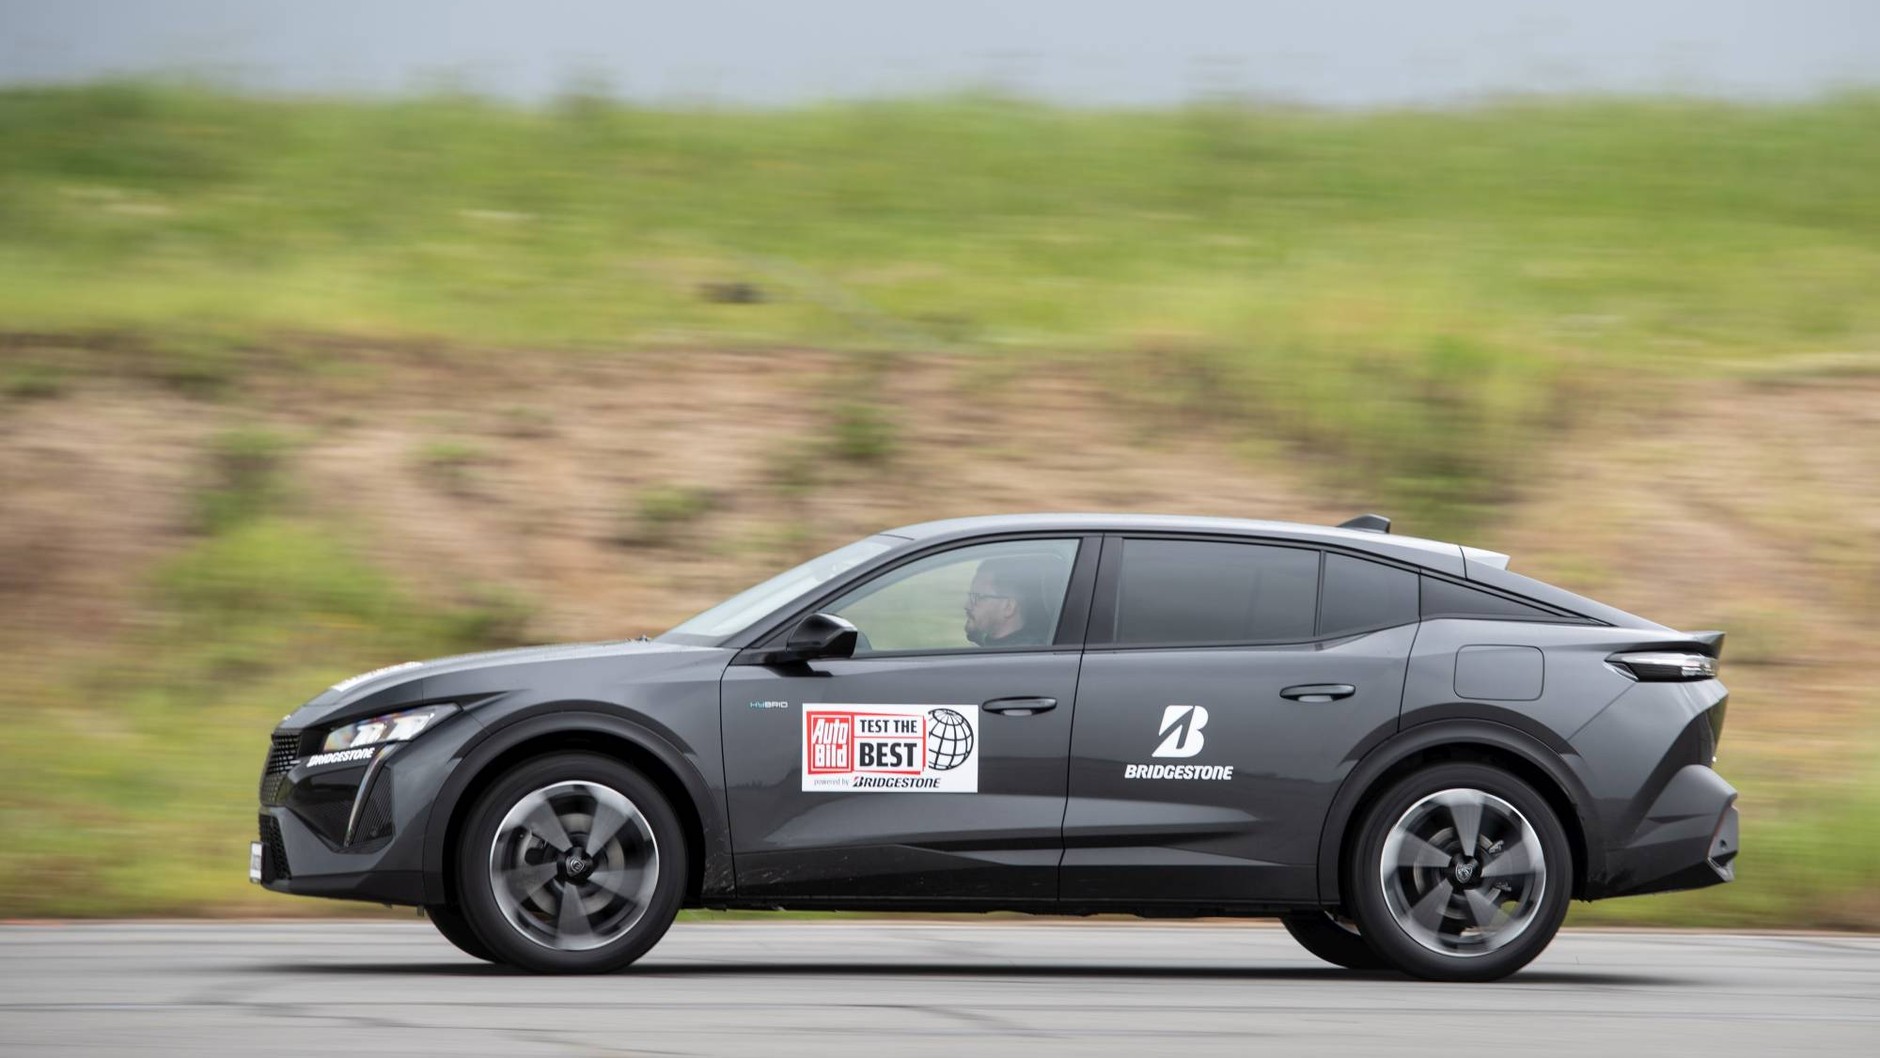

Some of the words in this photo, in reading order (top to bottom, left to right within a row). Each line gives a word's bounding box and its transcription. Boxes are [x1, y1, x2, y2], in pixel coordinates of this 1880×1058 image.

[812, 718, 849, 744] Auto
[860, 719, 889, 733] TEST
[893, 719, 917, 733] THE
[814, 743, 848, 768] Bild
[859, 742, 917, 768] BEST
[814, 777, 841, 786] powered
[842, 777, 849, 786] by
[853, 776, 941, 788] BRIDGESTONE
[1124, 764, 1234, 780] BRIDGESTONE
